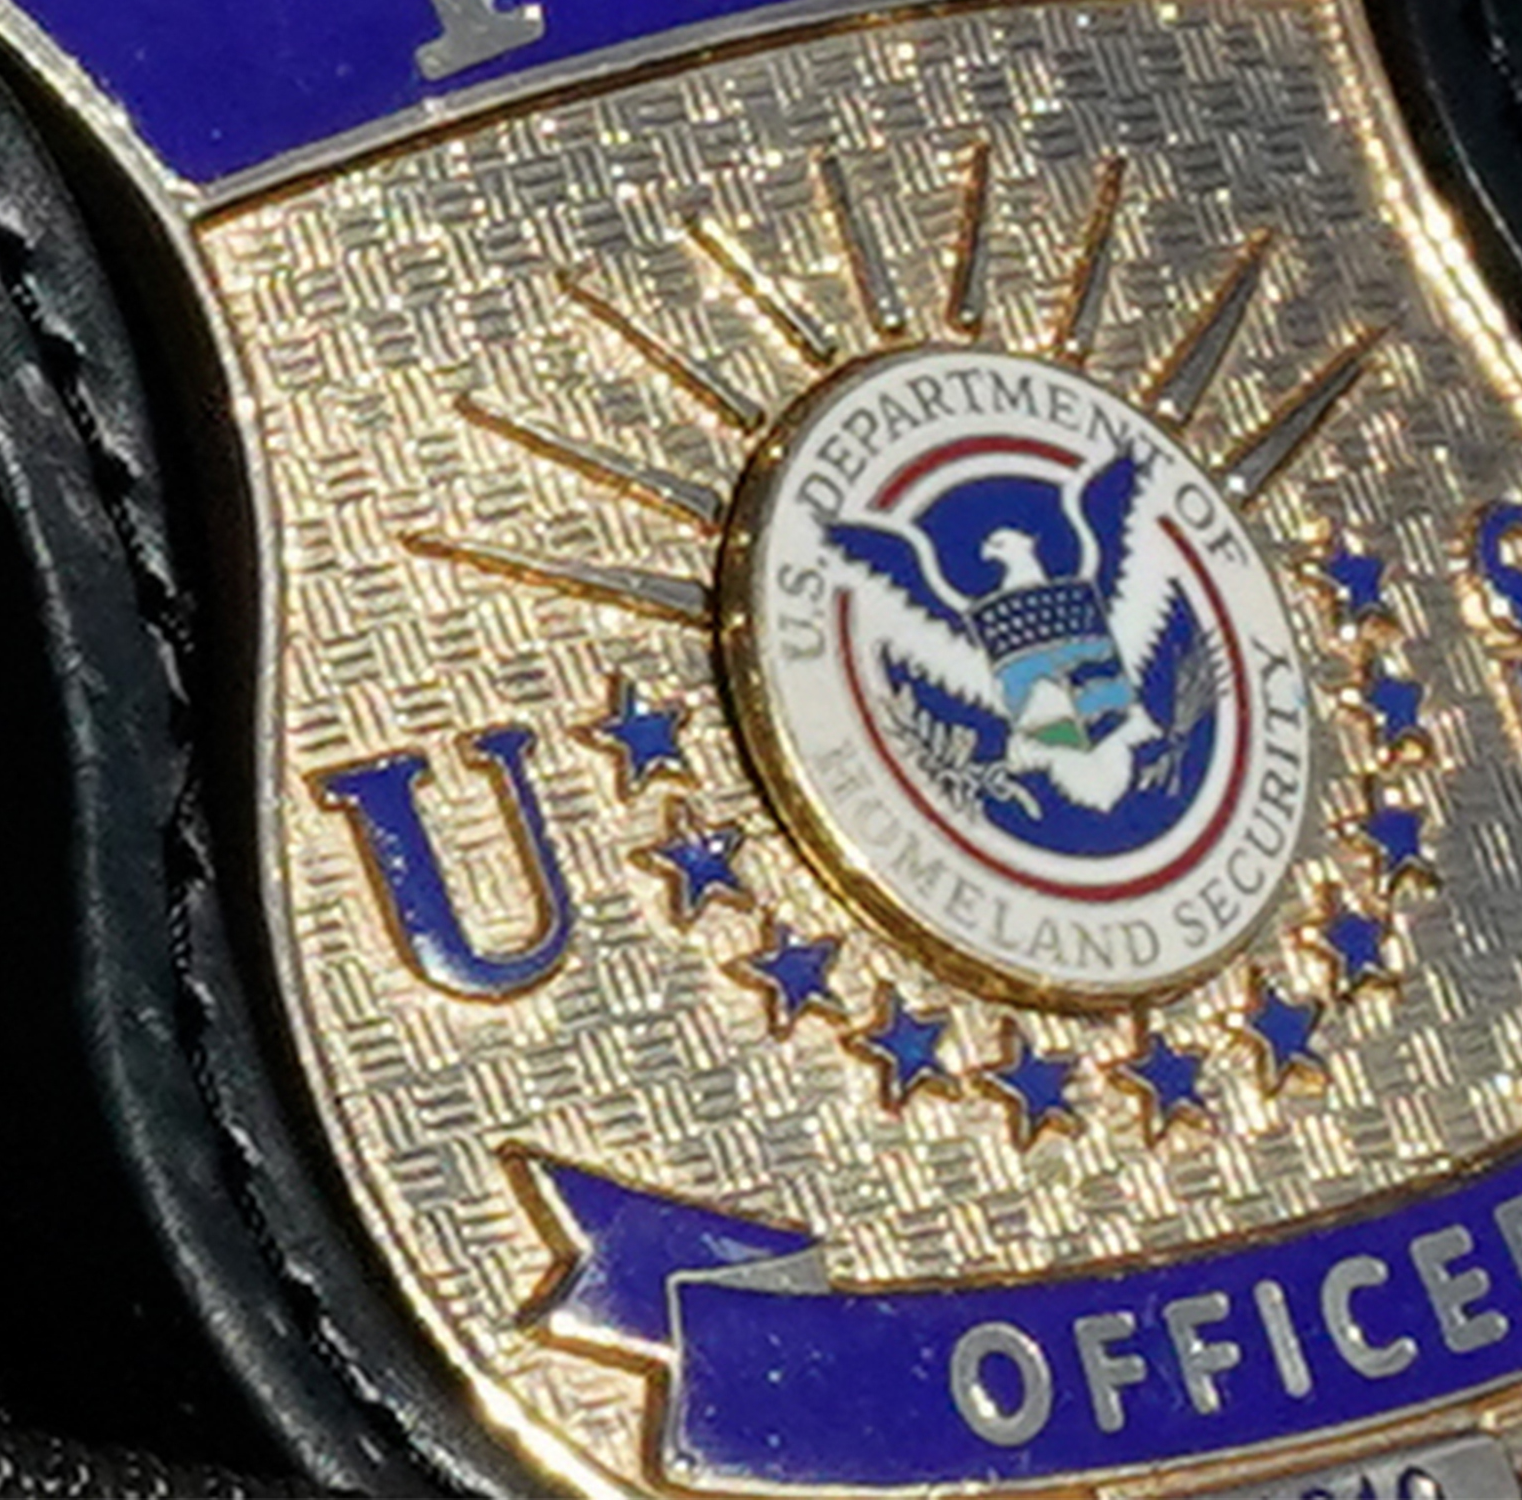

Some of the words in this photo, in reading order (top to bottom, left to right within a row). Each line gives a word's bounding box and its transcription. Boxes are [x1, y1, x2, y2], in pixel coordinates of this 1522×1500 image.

[796, 366, 1175, 528] DEPARTMENT
[1174, 482, 1248, 568] OF
[777, 555, 828, 660] U.S.
[306, 726, 577, 1002] U
[821, 739, 1161, 968] HOMELAND
[1173, 636, 1302, 949] SECURITY
